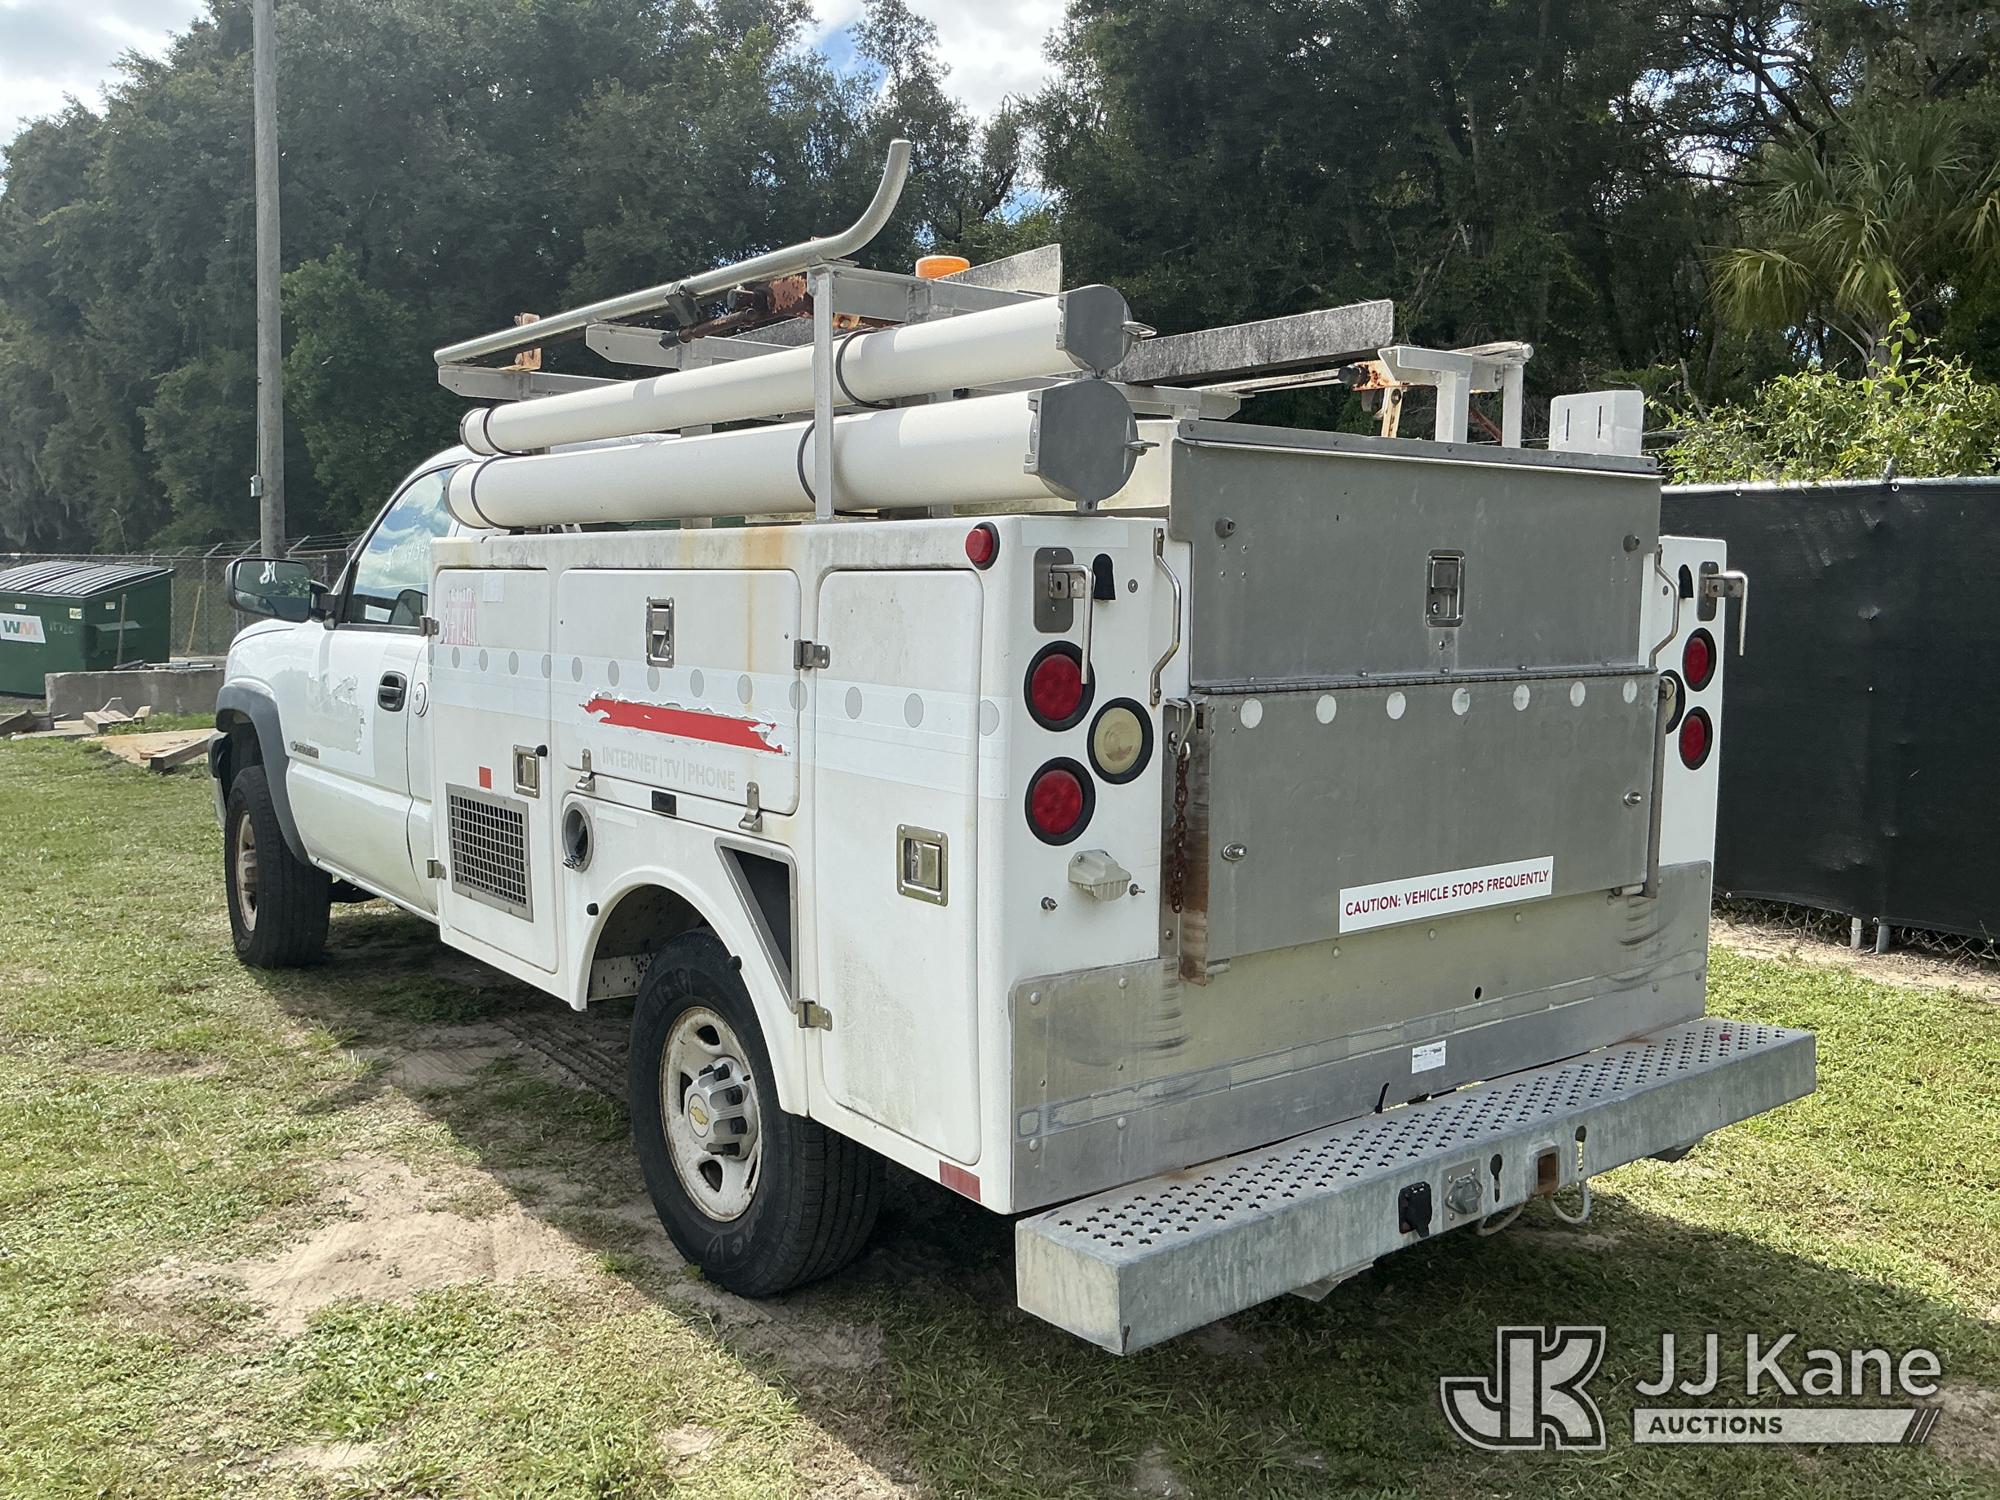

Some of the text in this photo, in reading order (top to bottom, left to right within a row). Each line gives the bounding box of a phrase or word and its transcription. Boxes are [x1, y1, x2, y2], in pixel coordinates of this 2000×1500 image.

[2, 619, 39, 636] WM
[602, 746, 658, 775] INTERNET
[687, 762, 737, 792] PHONE
[1345, 870, 1549, 916] CAUTION: VEHICLE STOPS FREQUENTLY
